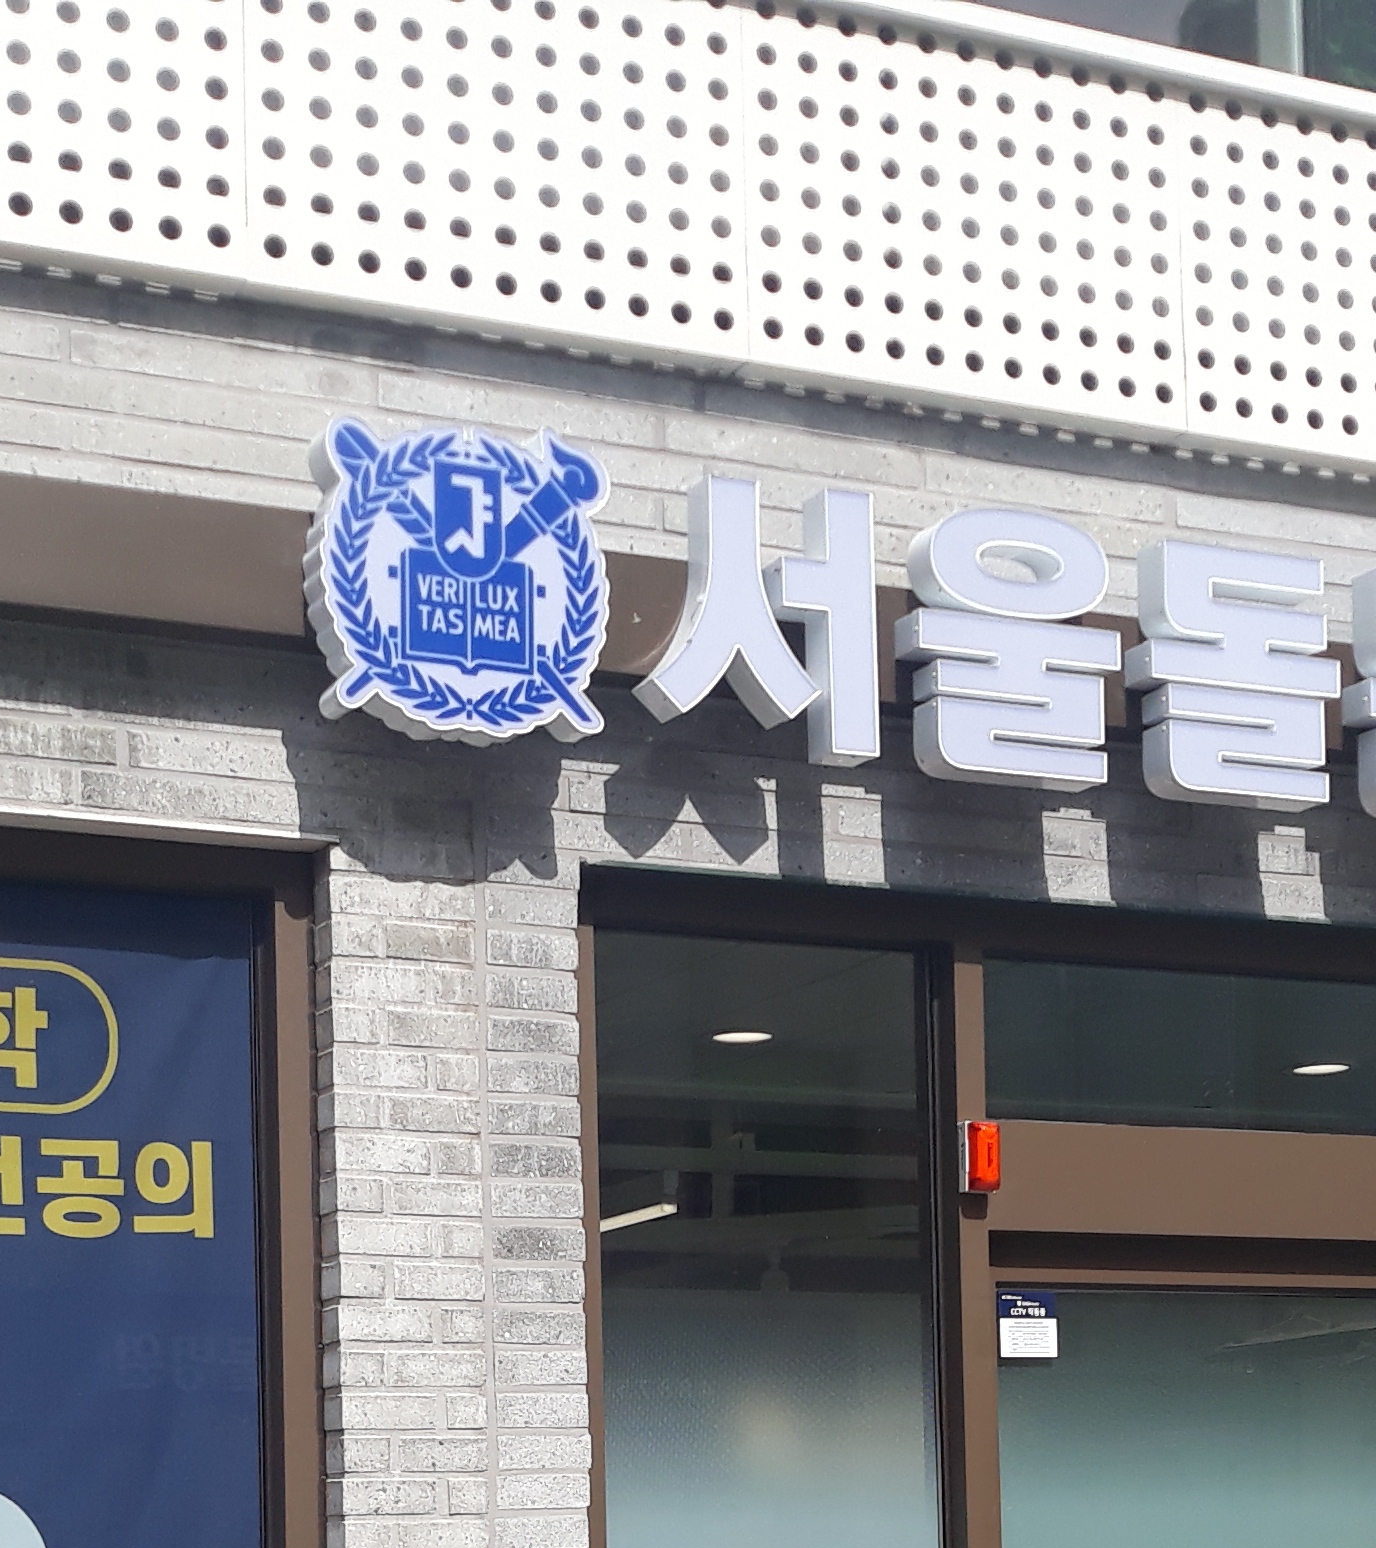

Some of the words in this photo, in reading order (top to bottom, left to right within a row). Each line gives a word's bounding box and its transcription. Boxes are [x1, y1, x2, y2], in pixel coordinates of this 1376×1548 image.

[416, 573, 465, 603] VERI
[474, 581, 520, 612] LUX
[417, 604, 465, 636] TAS
[473, 614, 521, 644] MEA
